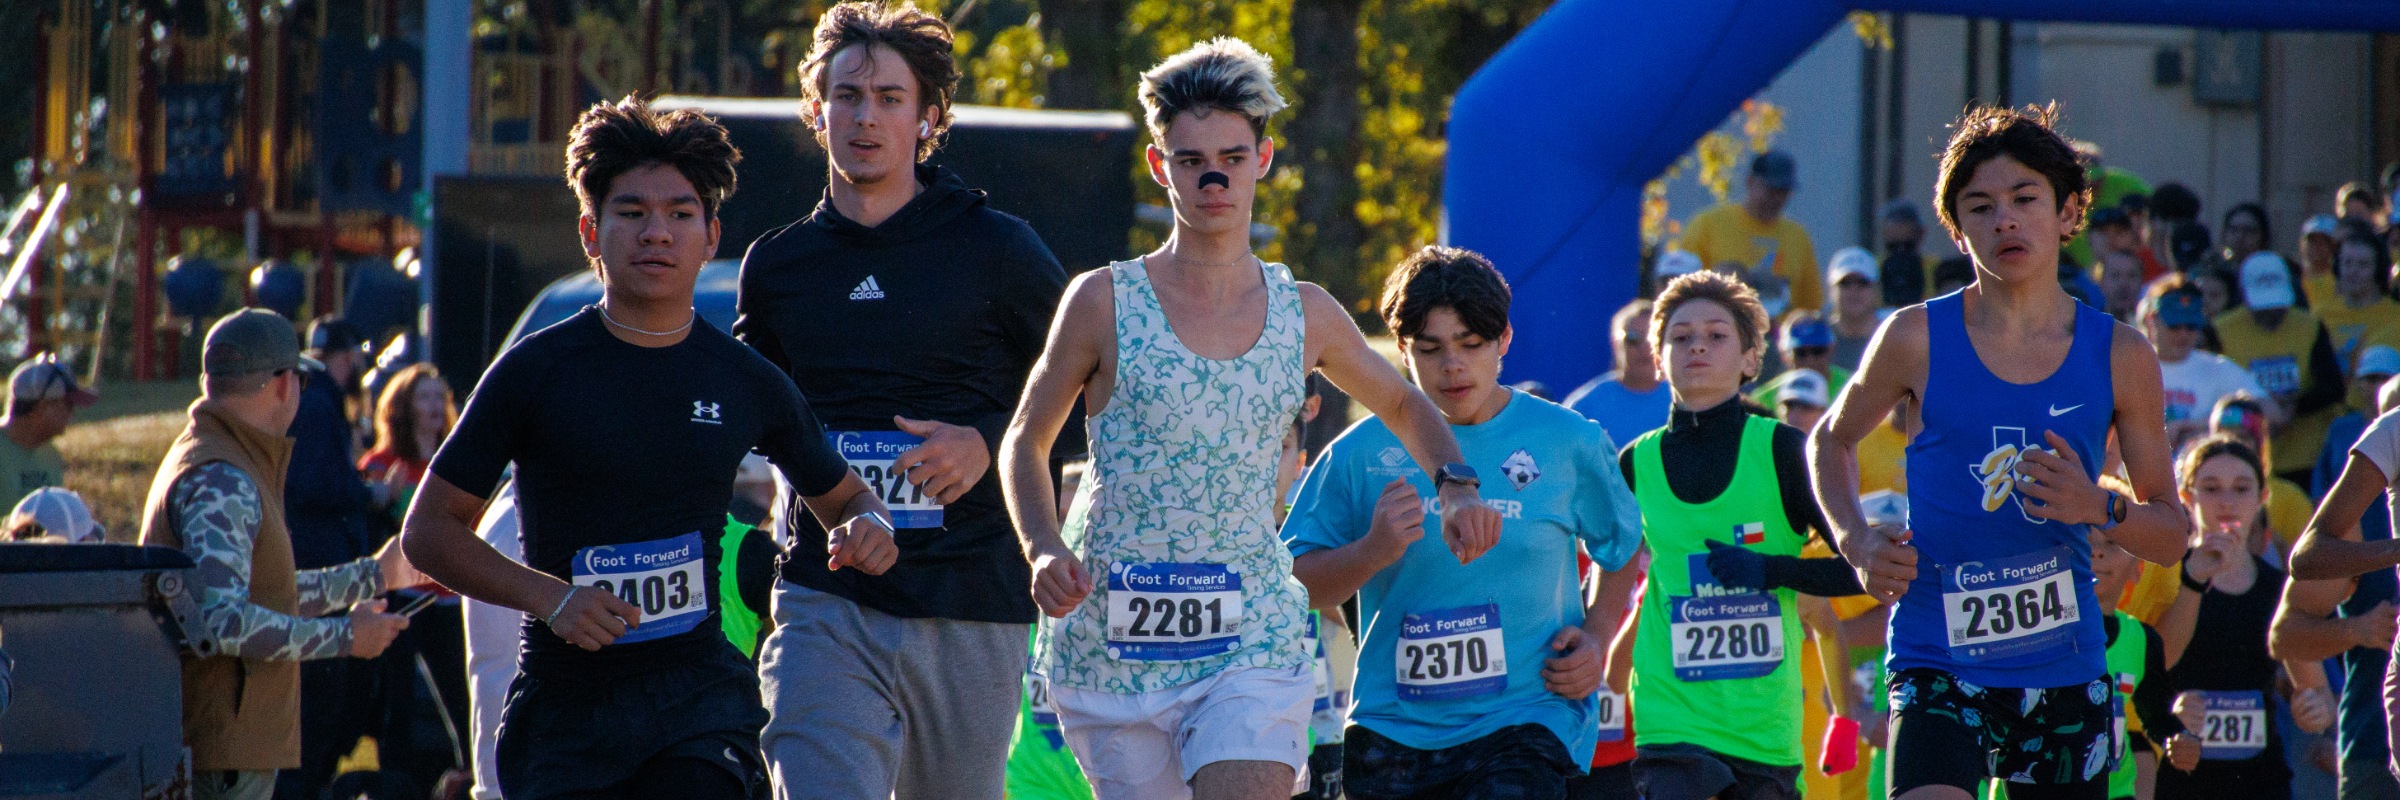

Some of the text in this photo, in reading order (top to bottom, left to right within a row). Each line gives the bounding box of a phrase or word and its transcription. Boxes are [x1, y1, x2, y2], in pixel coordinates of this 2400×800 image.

[850, 290, 885, 300] adidas
[843, 441, 921, 453] Foot Forwar
[849, 465, 922, 504] 327
[593, 544, 690, 567] Foot Forward
[1129, 572, 1226, 586] Foot Forward
[1962, 556, 2058, 584] Foot Forward
[2039, 568, 2058, 577] Services
[1128, 596, 1222, 637] 2281
[1687, 601, 1769, 617] Foot Forward
[1962, 580, 2065, 639] 2364
[1403, 613, 1487, 634] Foot Forward
[1686, 622, 1771, 661] 2280
[1405, 637, 1489, 680] 2370
[2201, 714, 2253, 742] 287
